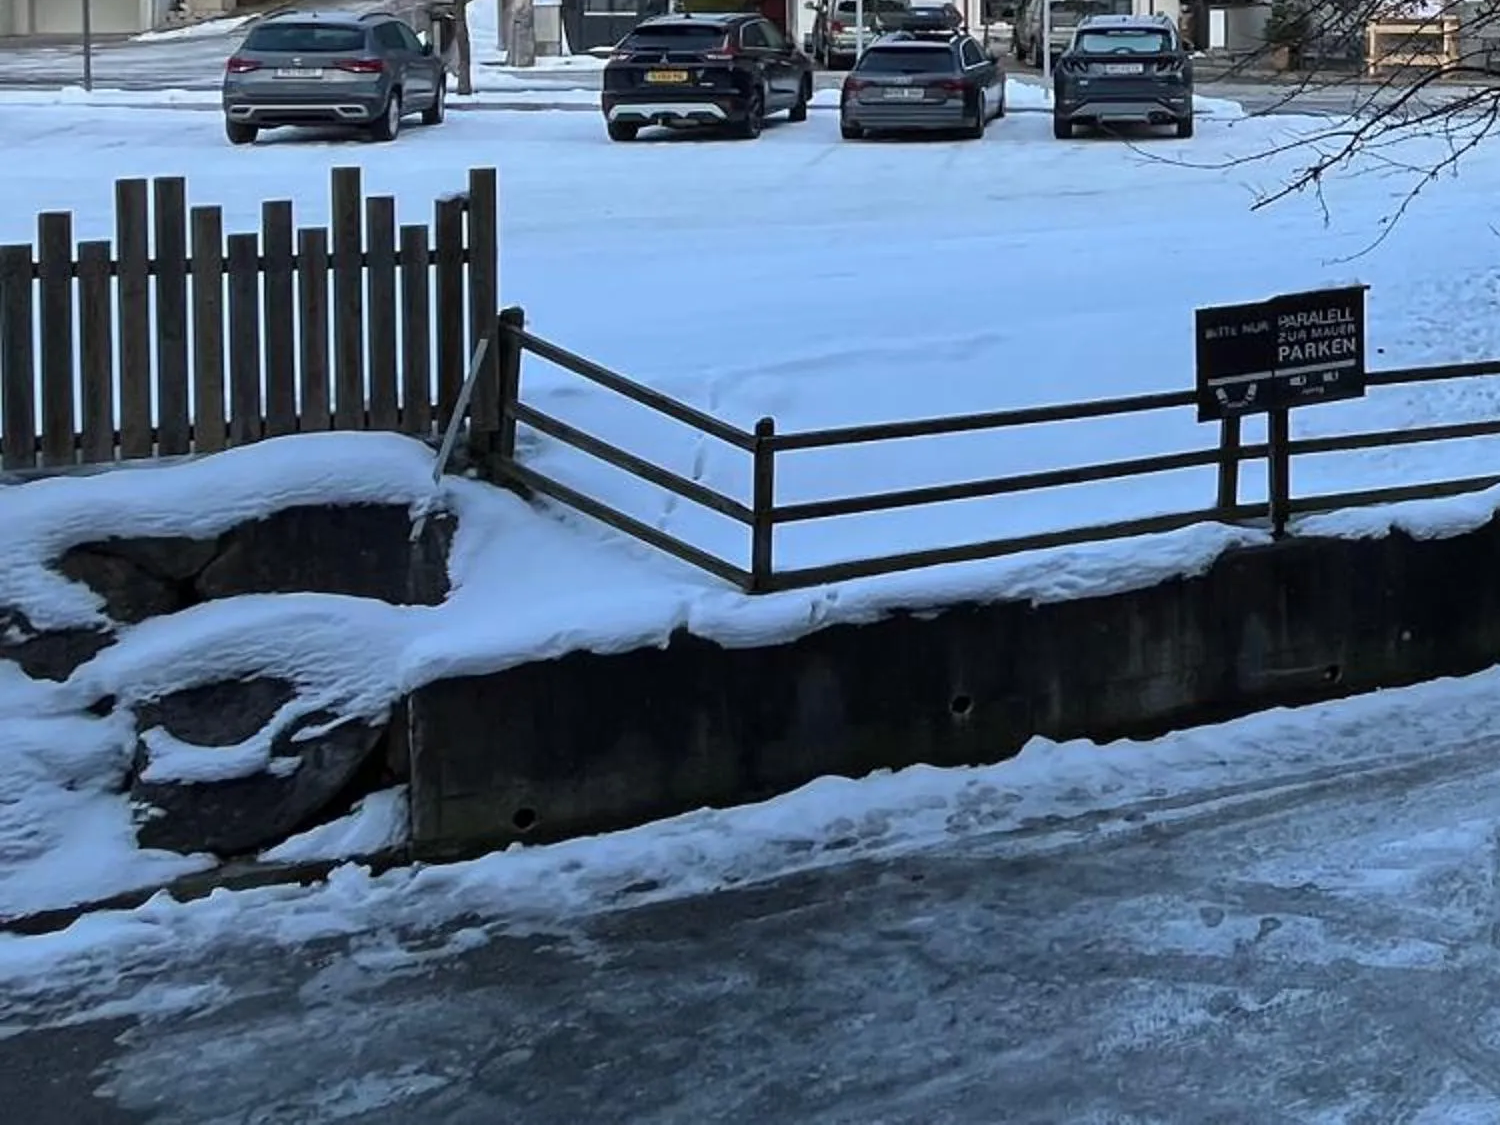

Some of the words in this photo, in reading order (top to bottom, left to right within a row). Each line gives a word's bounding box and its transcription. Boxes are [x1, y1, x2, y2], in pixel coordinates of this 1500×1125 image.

[1241, 319, 1269, 335] NUR
[1278, 306, 1355, 328] PARALELL
[1278, 328, 1307, 344] ZUR
[1310, 322, 1356, 340] MAUER
[1279, 336, 1356, 362] PARKEN
